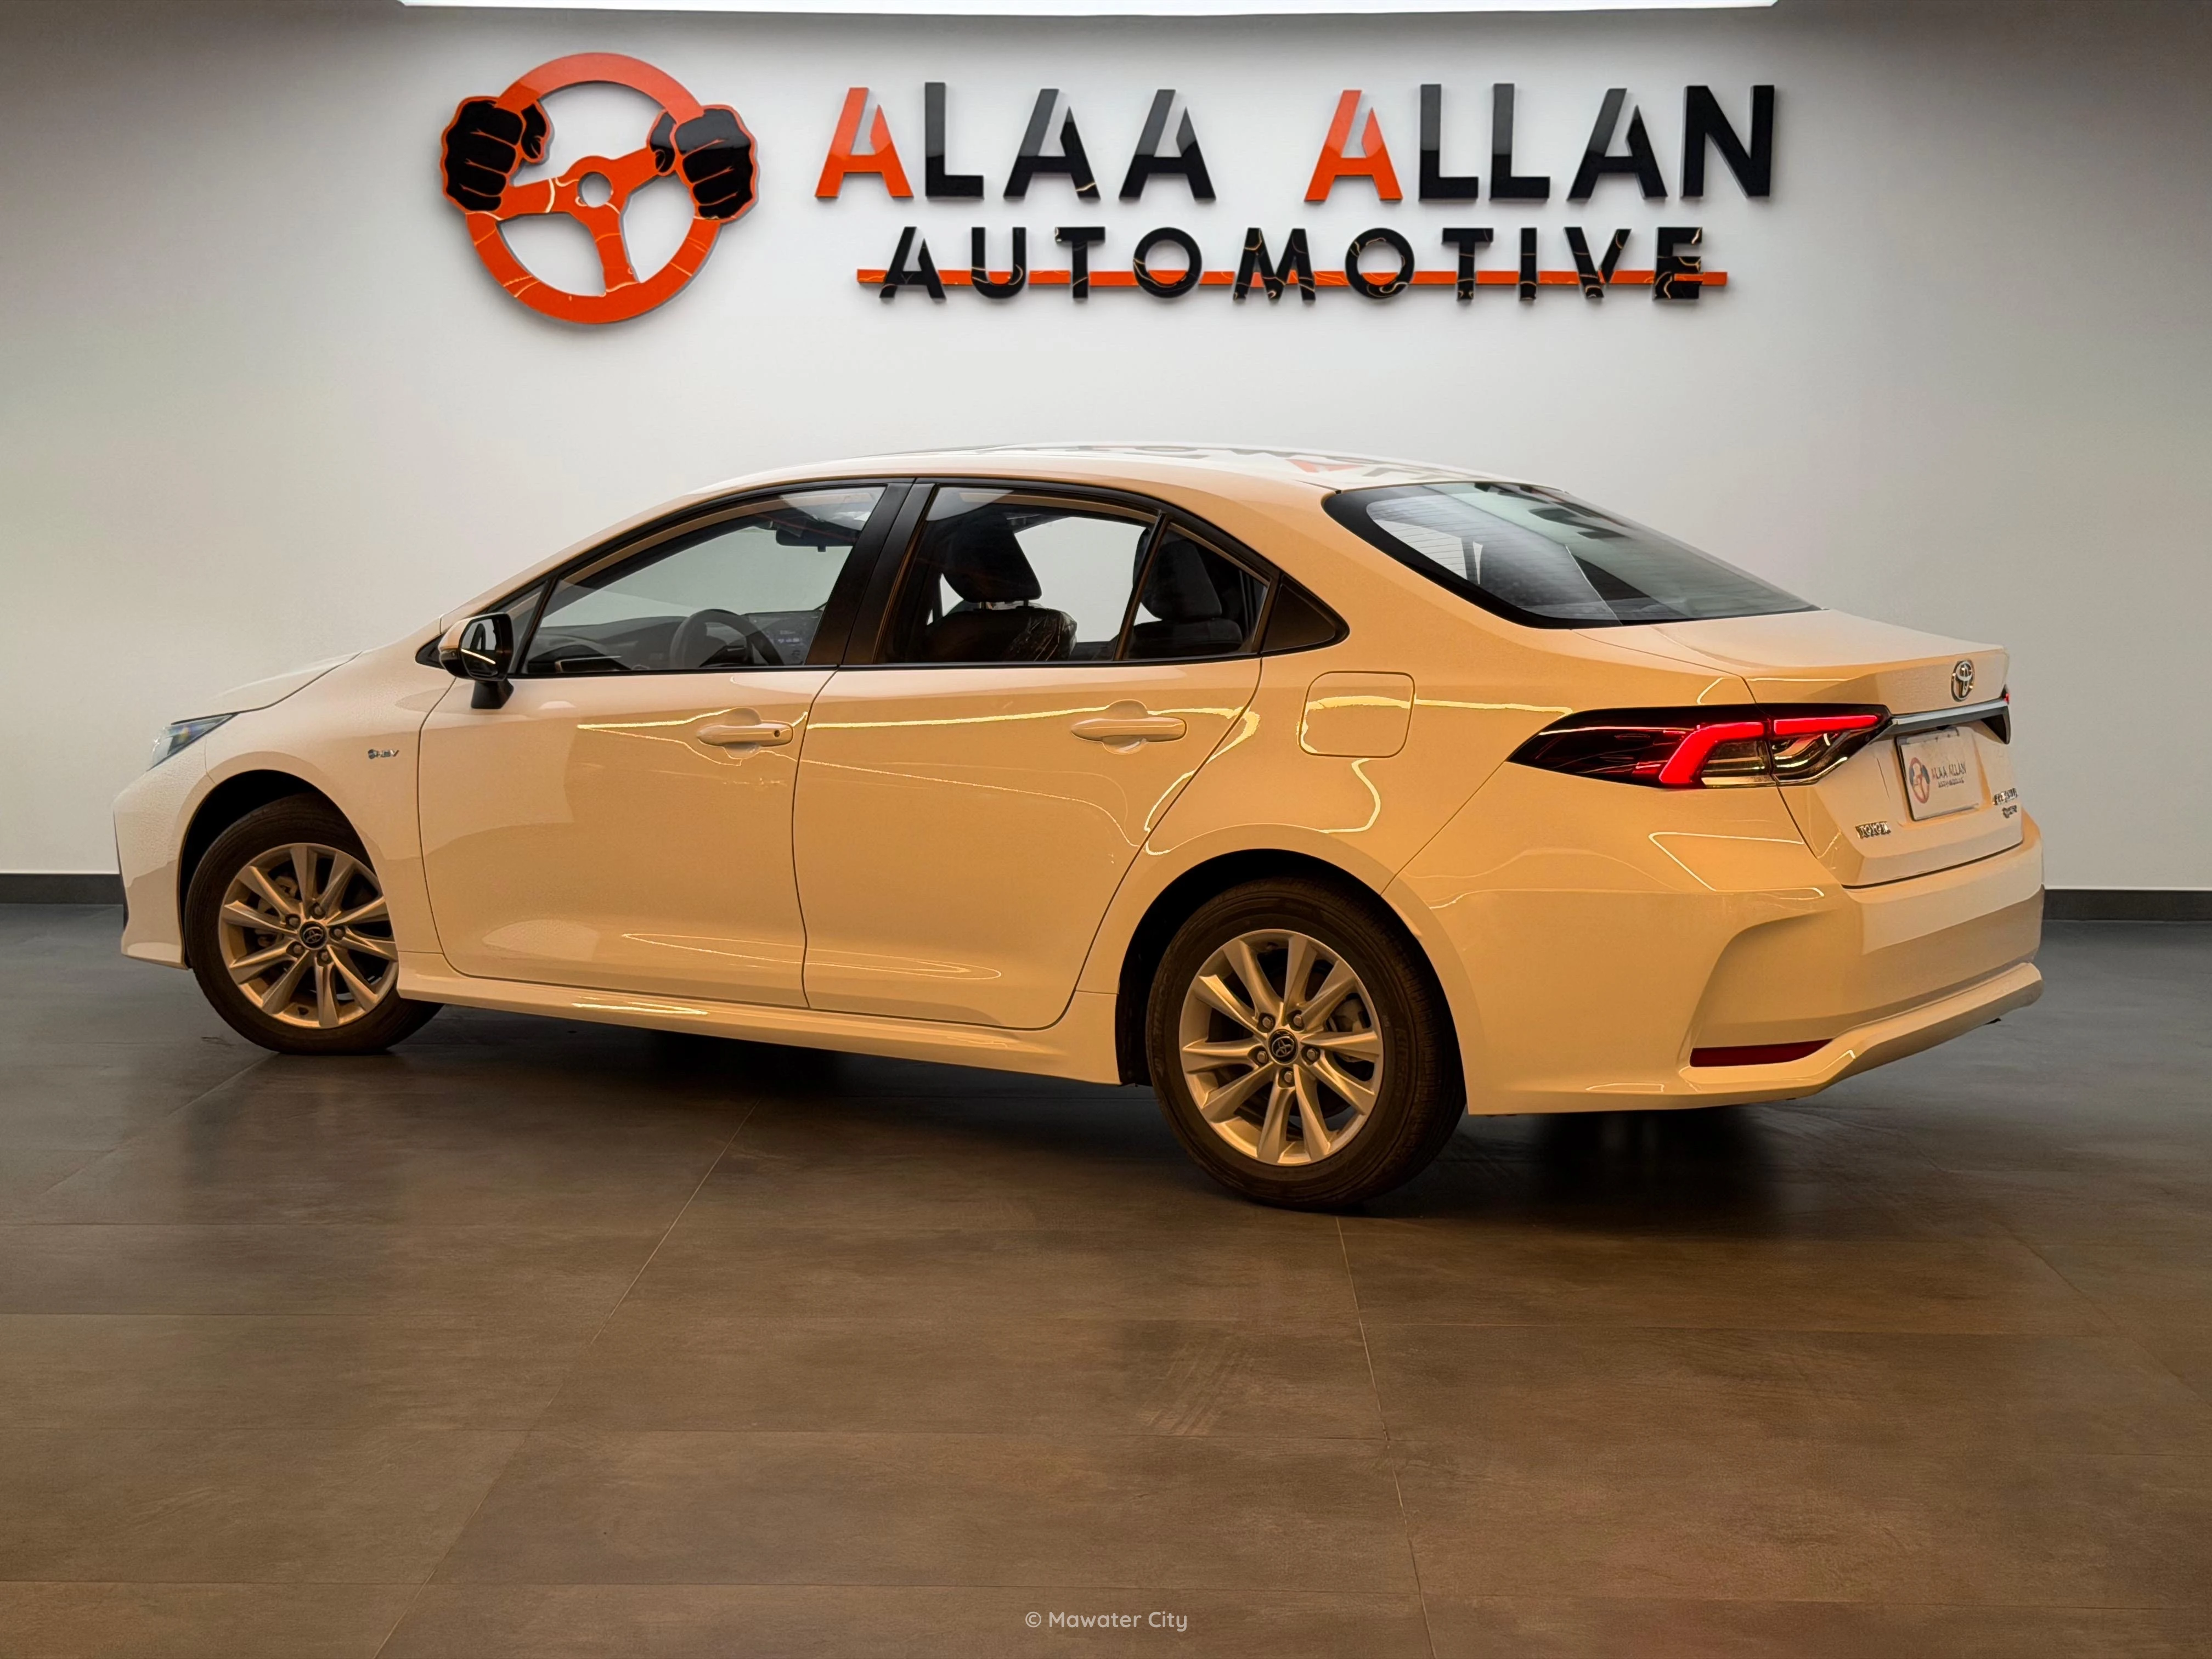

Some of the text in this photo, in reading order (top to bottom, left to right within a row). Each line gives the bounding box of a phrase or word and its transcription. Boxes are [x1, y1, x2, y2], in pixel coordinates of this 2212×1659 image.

[815, 82, 1775, 205] ALAA ALLAN
[879, 227, 1703, 302] AUTOMOTIVE
